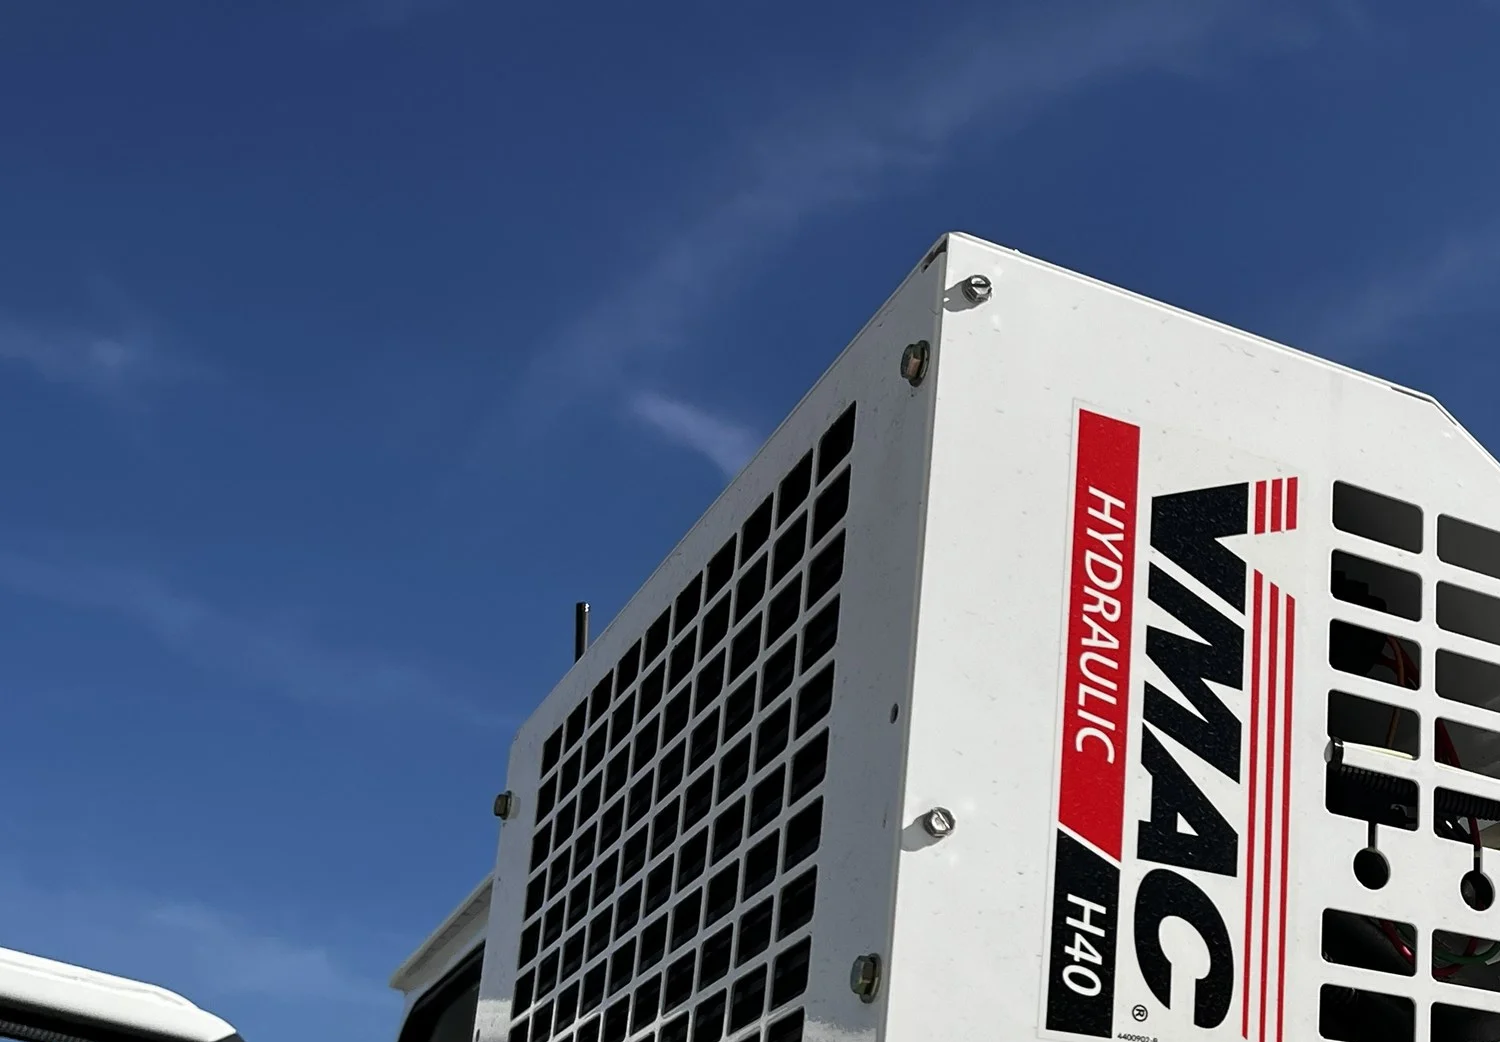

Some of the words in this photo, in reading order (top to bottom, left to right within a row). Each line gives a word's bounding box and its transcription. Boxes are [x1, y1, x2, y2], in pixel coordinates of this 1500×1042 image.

[1074, 484, 1126, 766] HYDRAULIC
[1134, 480, 1250, 1029] VMAC
[1061, 892, 1107, 998] H40
